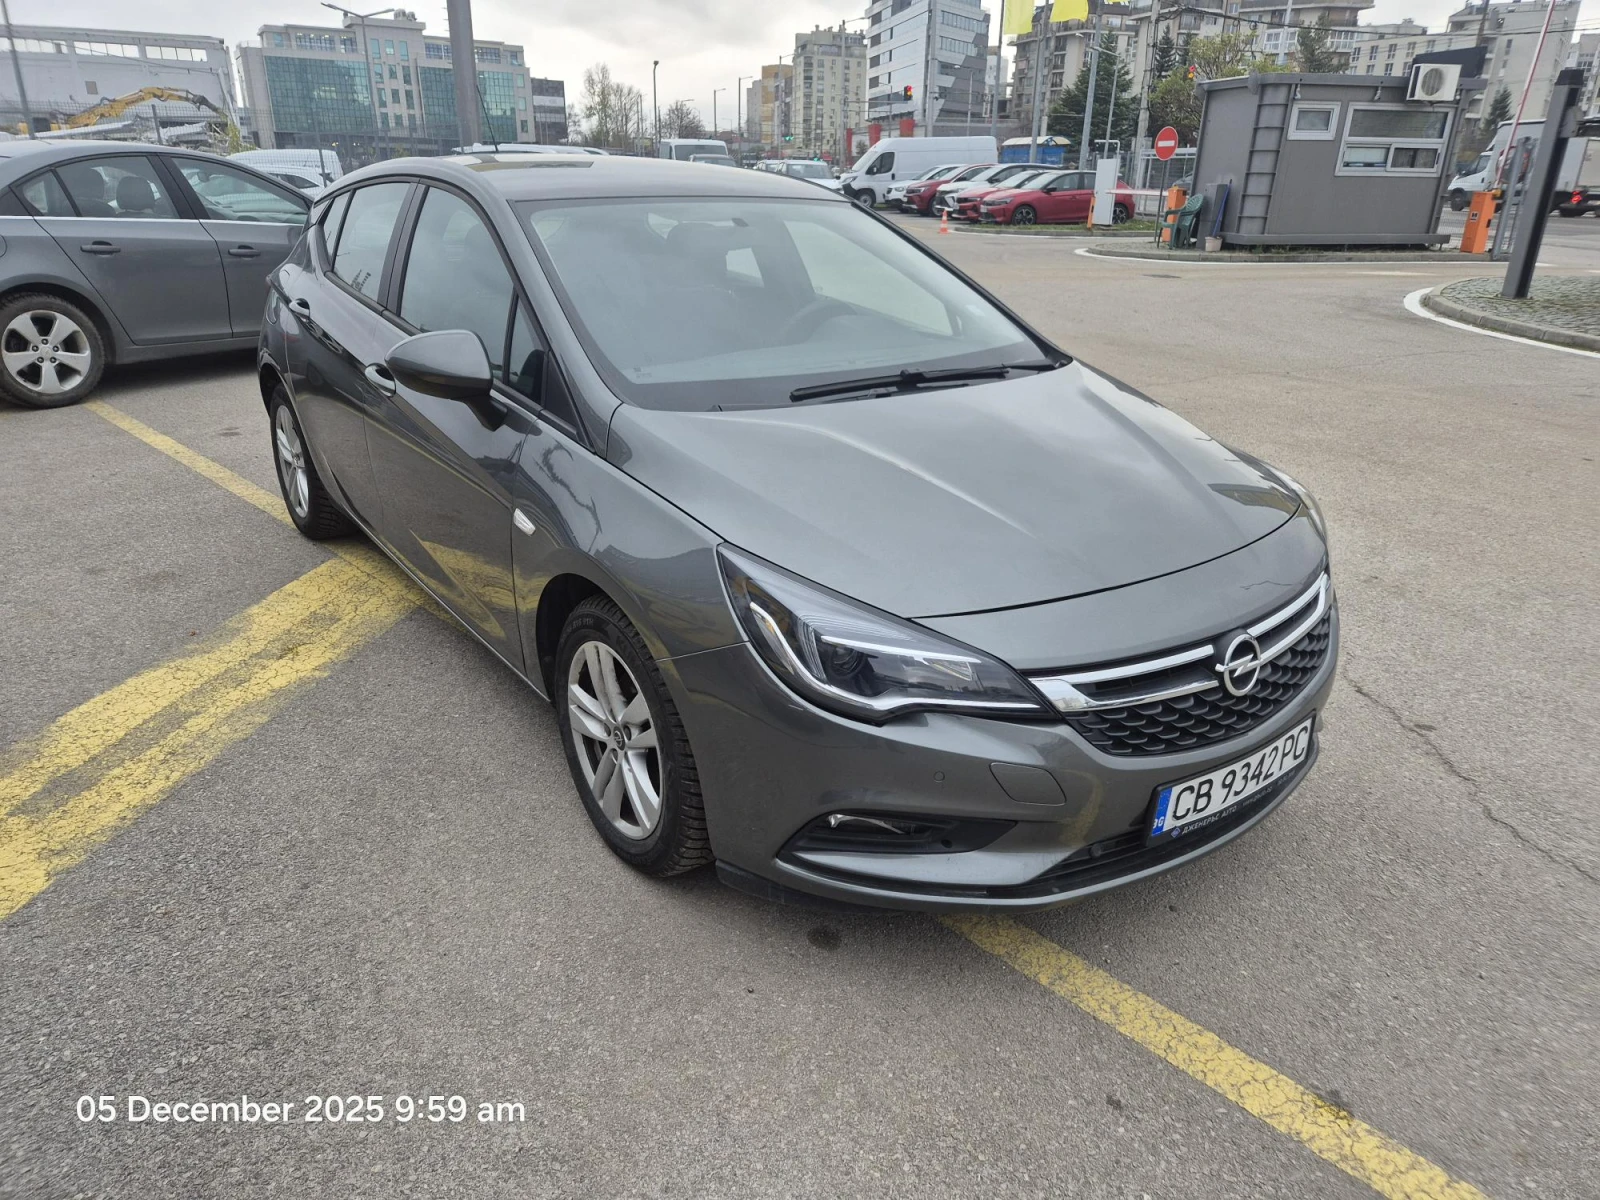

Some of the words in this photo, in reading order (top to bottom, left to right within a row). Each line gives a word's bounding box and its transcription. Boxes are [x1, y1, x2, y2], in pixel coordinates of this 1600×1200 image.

[1172, 778, 1214, 821] CB
[1221, 745, 1280, 805] 9342
[1279, 725, 1309, 771] PC
